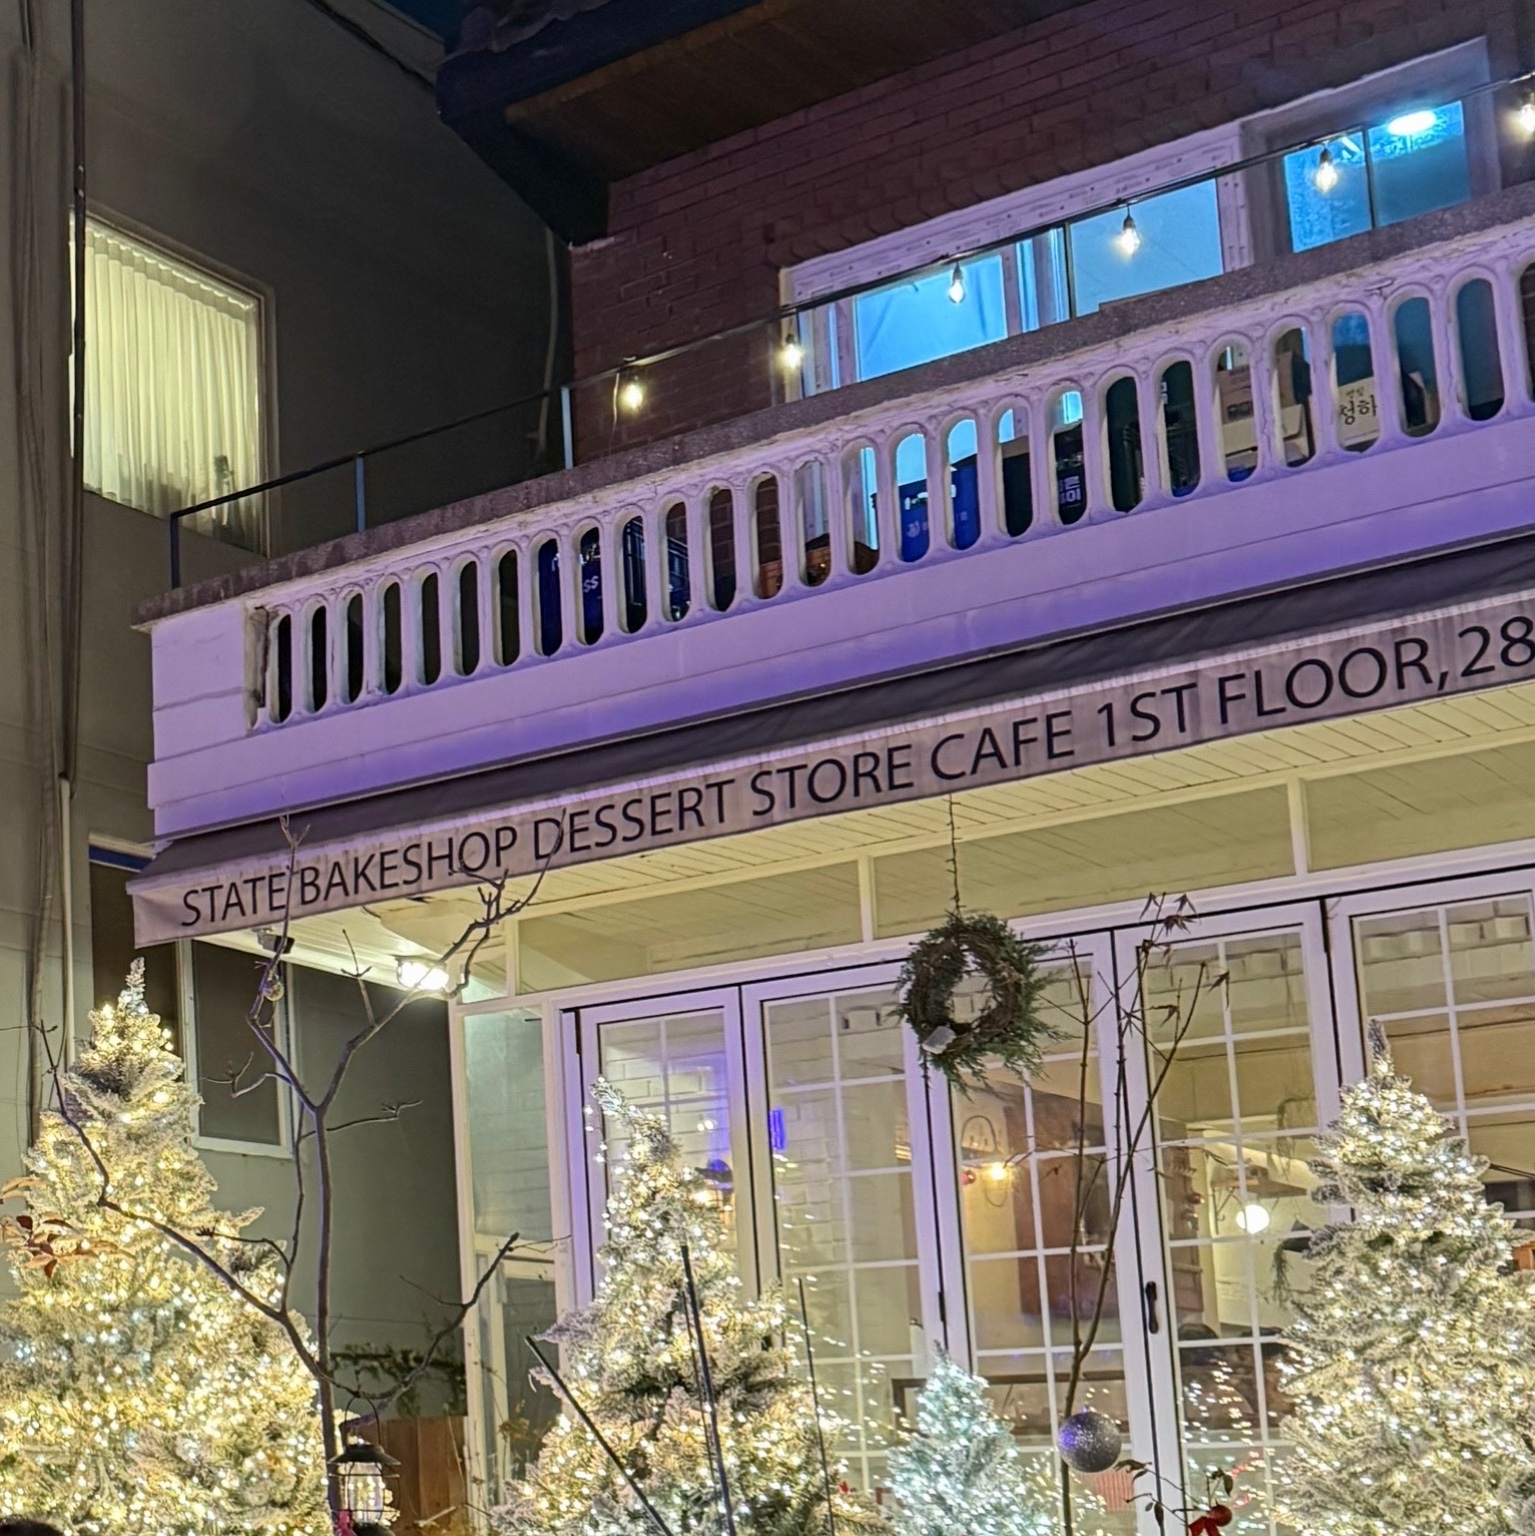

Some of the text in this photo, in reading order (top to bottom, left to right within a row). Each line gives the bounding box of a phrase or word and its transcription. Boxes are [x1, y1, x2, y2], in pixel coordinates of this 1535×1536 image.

[181, 872, 288, 928] STATE
[300, 826, 517, 906] BAKESHOP
[534, 779, 735, 861] DESSERT
[750, 744, 914, 817] STORE
[931, 710, 1075, 781] CAFE
[1097, 682, 1197, 748] 1ST
